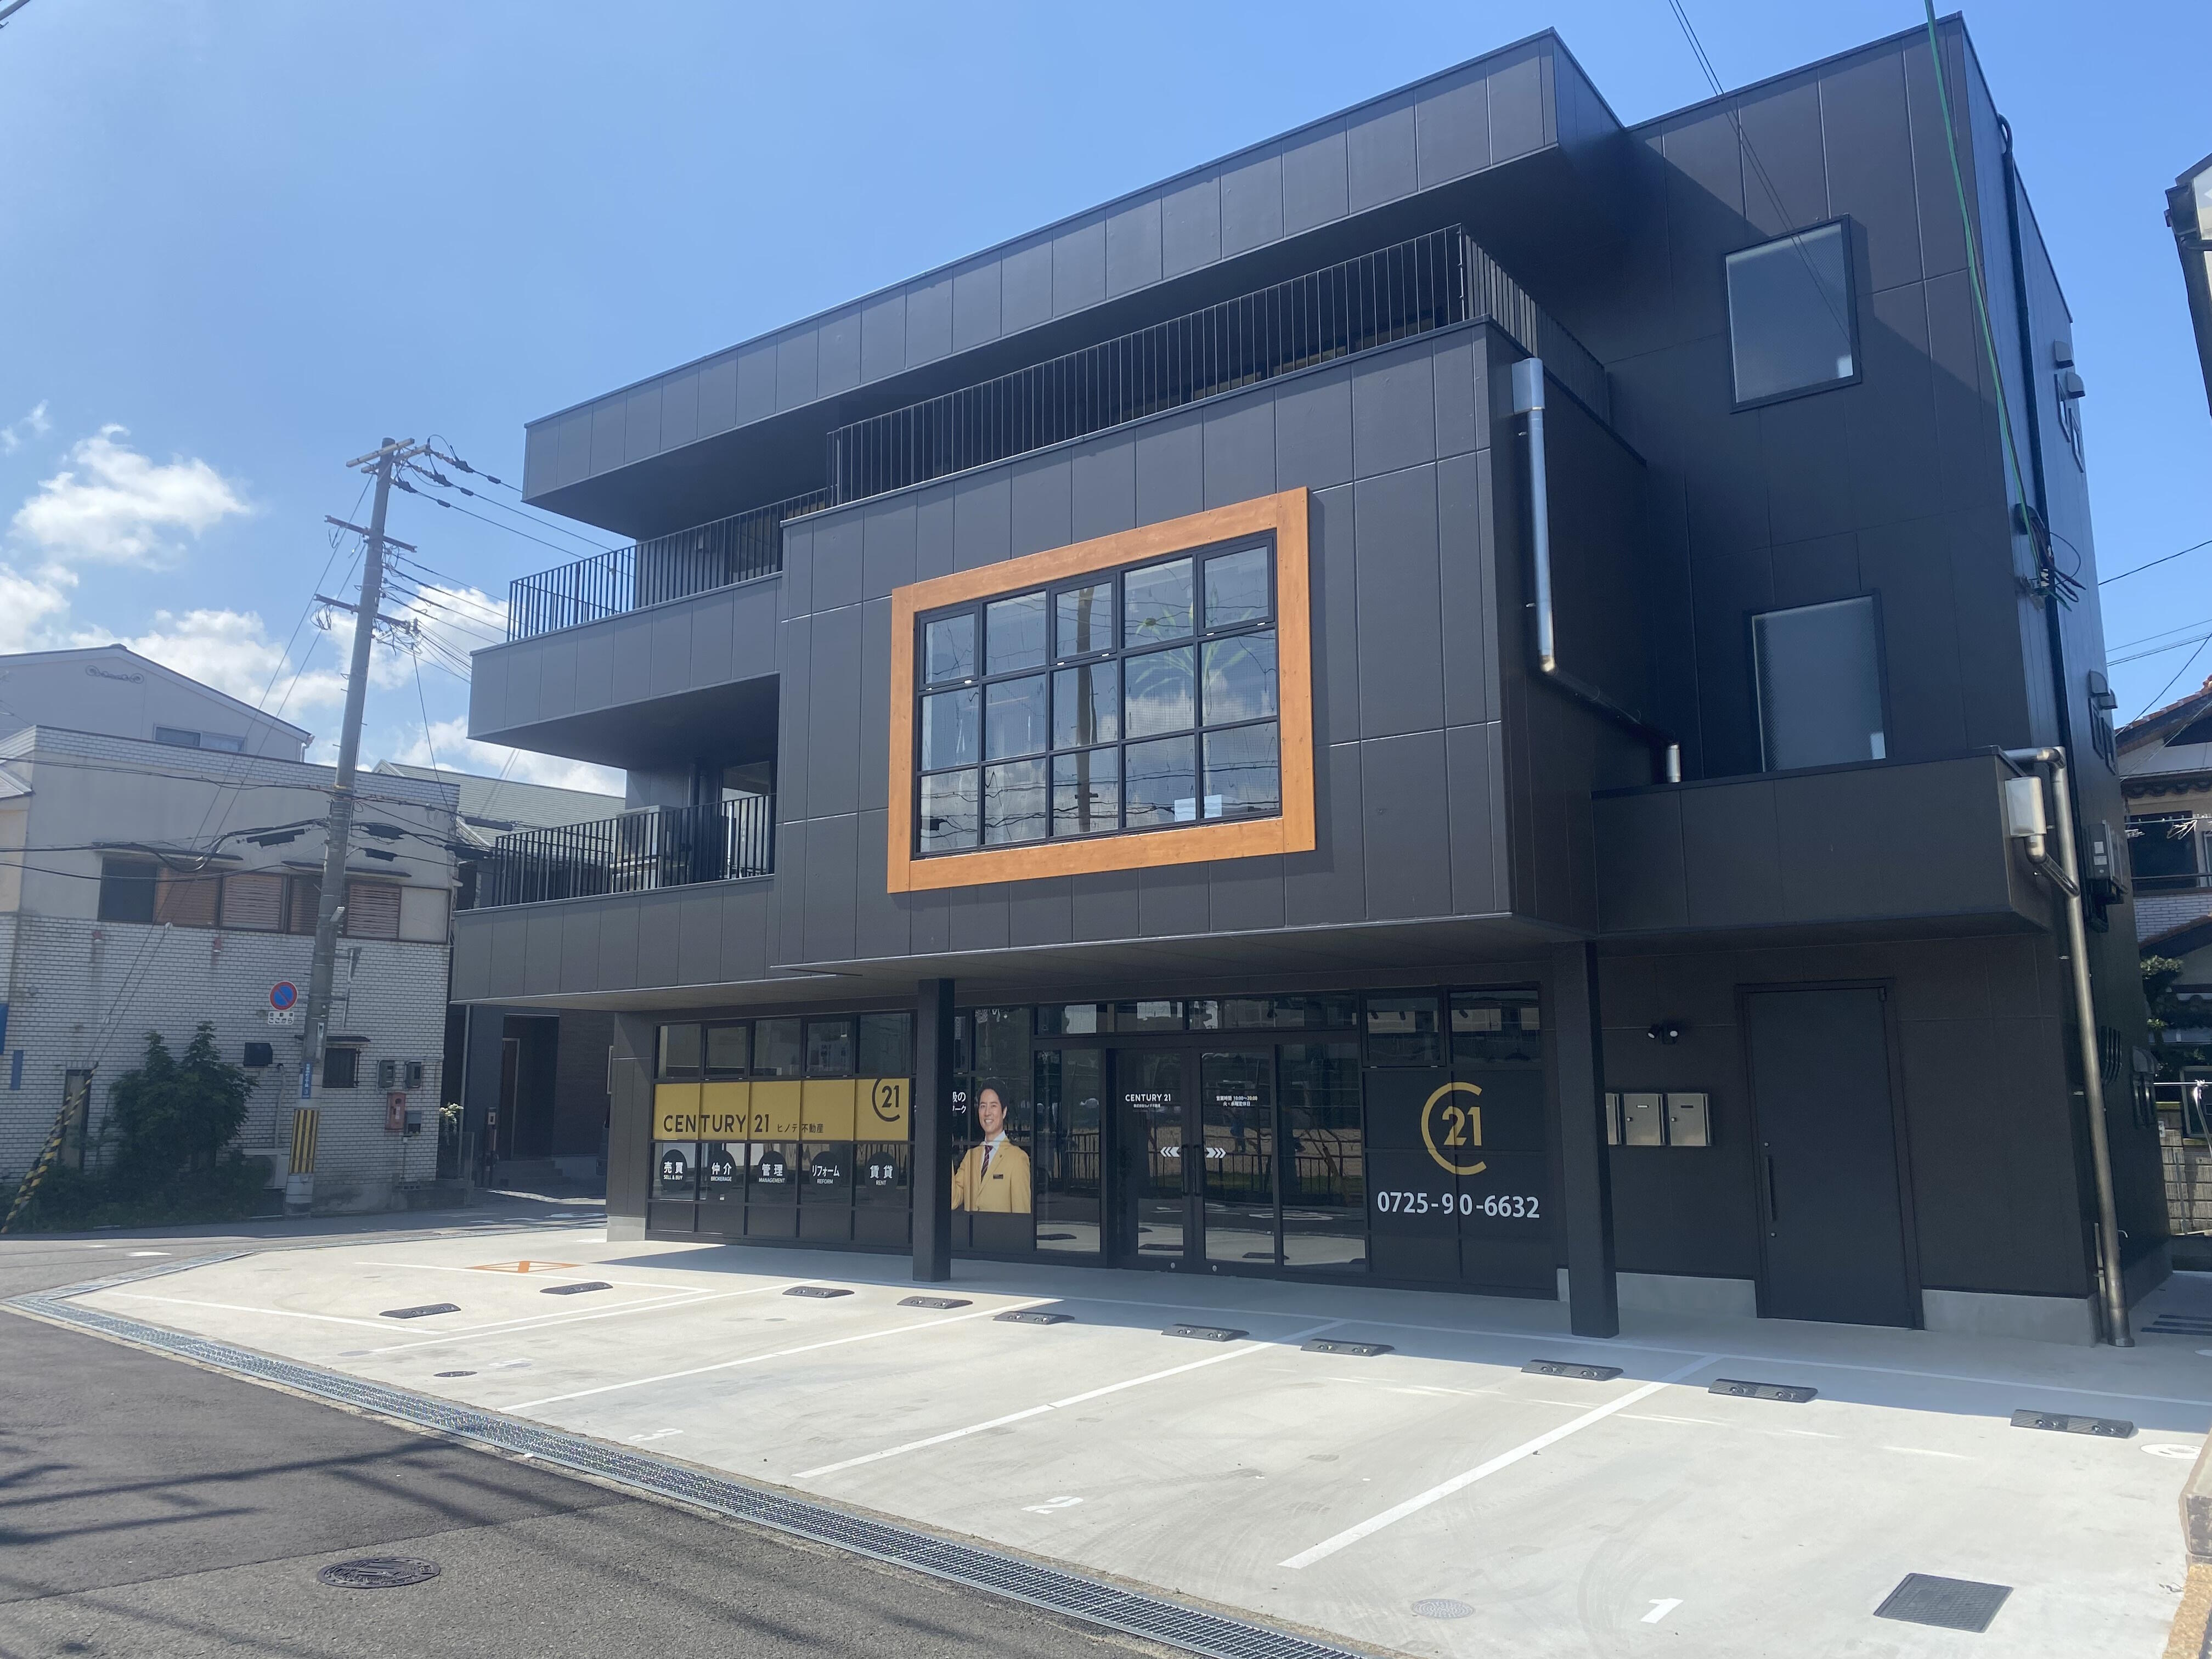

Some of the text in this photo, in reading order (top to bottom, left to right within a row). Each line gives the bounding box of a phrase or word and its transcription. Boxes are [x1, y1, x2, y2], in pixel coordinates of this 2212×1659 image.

[1125, 1093, 1171, 1102] CENTURY 21
[663, 1114, 747, 1133] CENTURY
[754, 1114, 769, 1133] 21
[811, 1164, 840, 1177] リフォーム
[1377, 1191, 1540, 1218] 0725-90-6632
[1020, 1496, 1084, 1515] 2
[1640, 1598, 1684, 1624] 1
